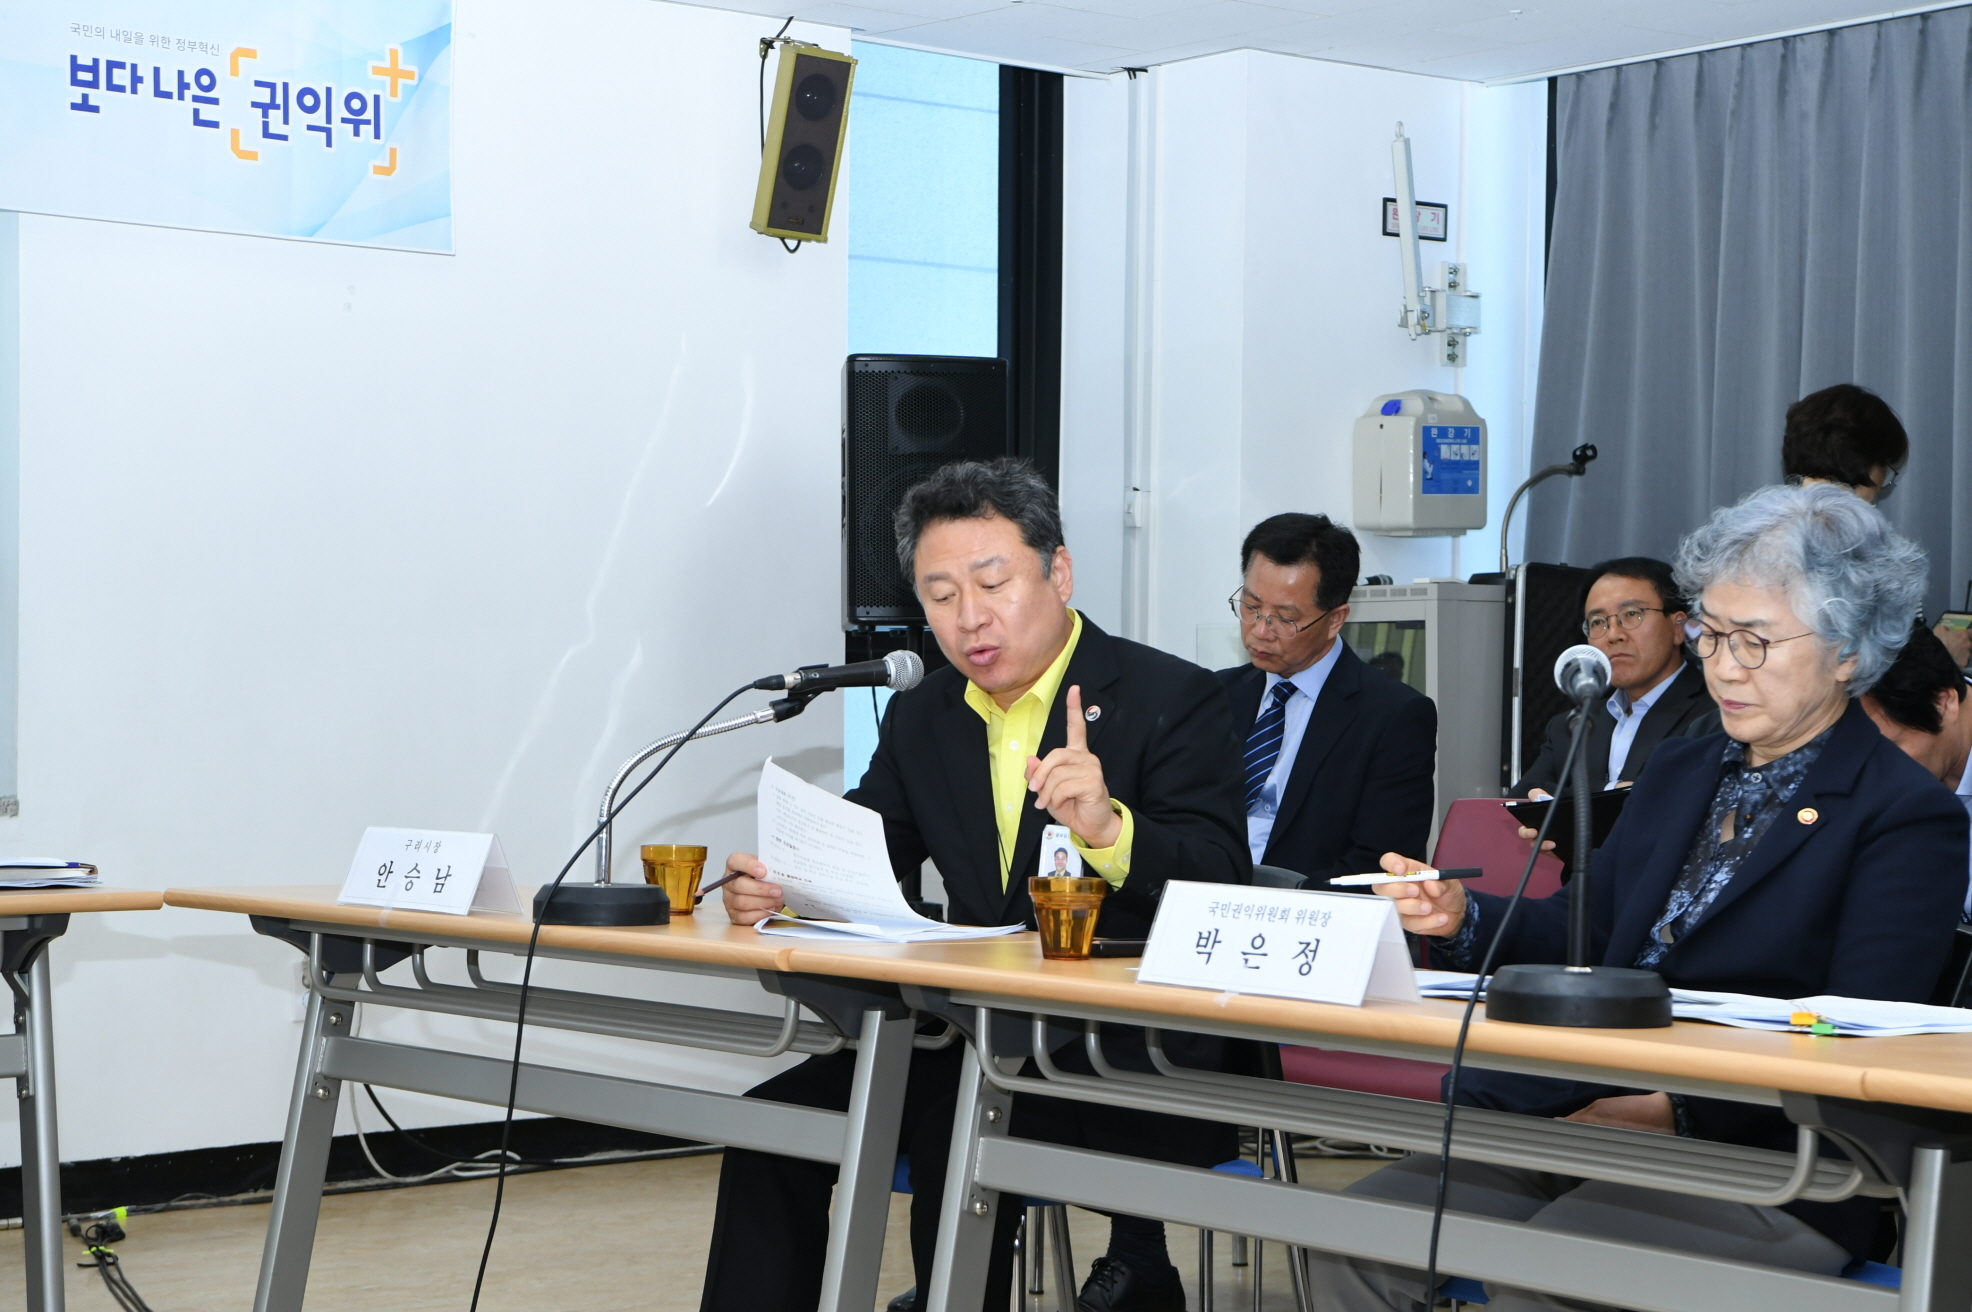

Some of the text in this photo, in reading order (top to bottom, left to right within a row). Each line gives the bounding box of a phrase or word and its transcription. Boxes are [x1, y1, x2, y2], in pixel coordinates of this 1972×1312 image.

[70, 22, 220, 57] 국민의 내일을 위한 정부혁신
[69, 54, 381, 148] 보다 나은 권익위
[404, 839, 442, 854] 구리시장
[1208, 901, 1332, 928] 국민권익위원회 위원장
